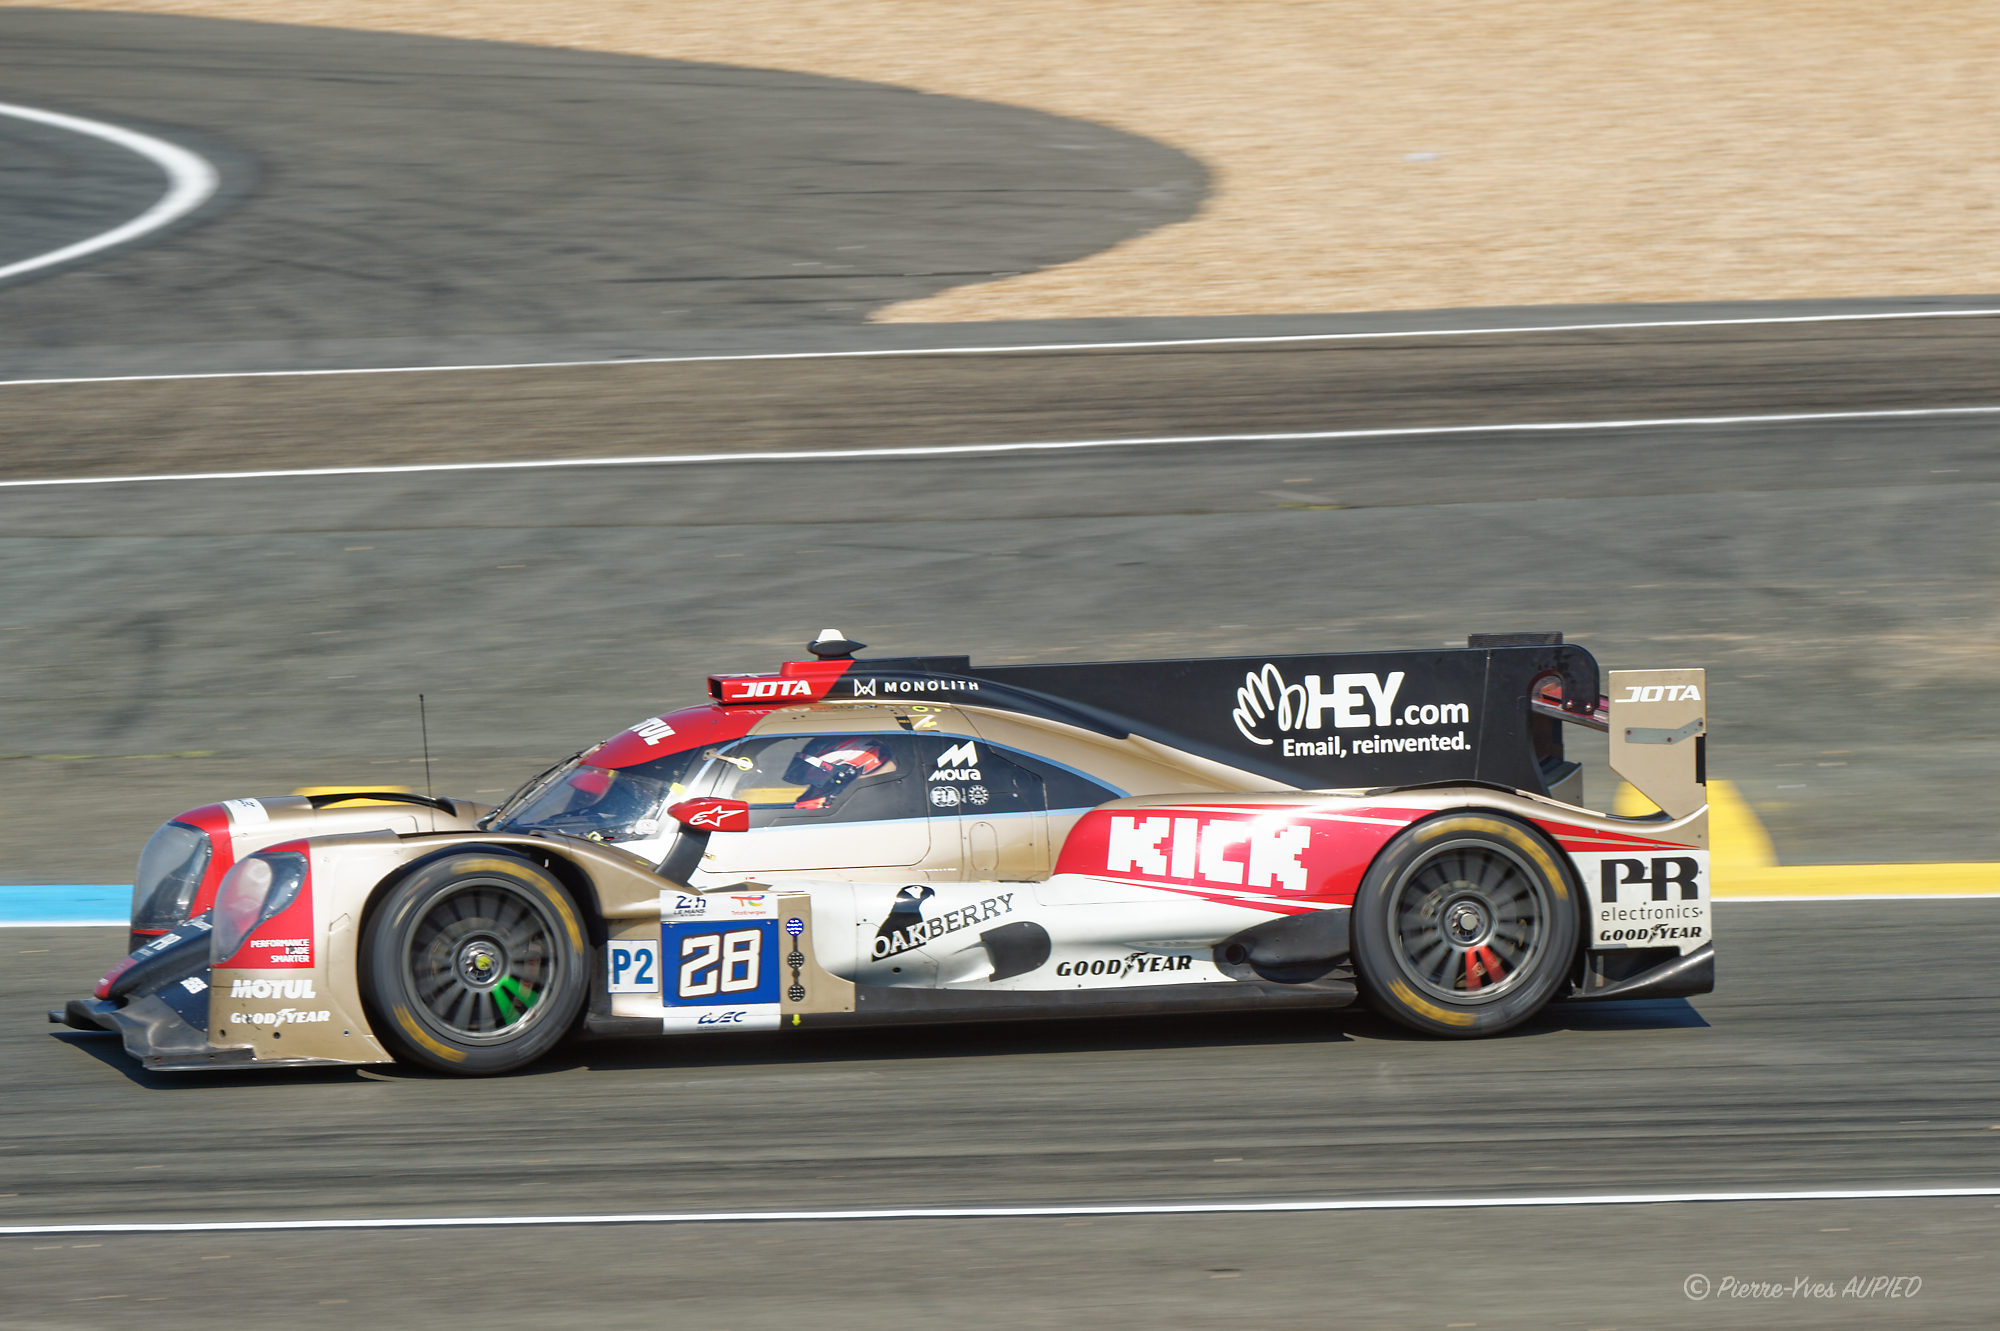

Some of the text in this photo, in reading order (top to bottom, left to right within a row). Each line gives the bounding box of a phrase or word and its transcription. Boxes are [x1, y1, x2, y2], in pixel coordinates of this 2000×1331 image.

[731, 680, 812, 698] JOTA
[884, 680, 980, 693] MONOLITH
[1614, 685, 1701, 703] JOTA
[1282, 731, 1471, 759] Email, reinvented.
[1106, 816, 1311, 891] KICK
[1601, 904, 1699, 921] electronics
[872, 893, 1014, 958] OAKBERRY
[250, 938, 310, 948] PERFORMANCE
[270, 954, 310, 963] SMARTER
[612, 948, 654, 985] P2
[679, 928, 763, 998] 28
[230, 979, 317, 999] MOTUL
[697, 1011, 748, 1025] WEC
